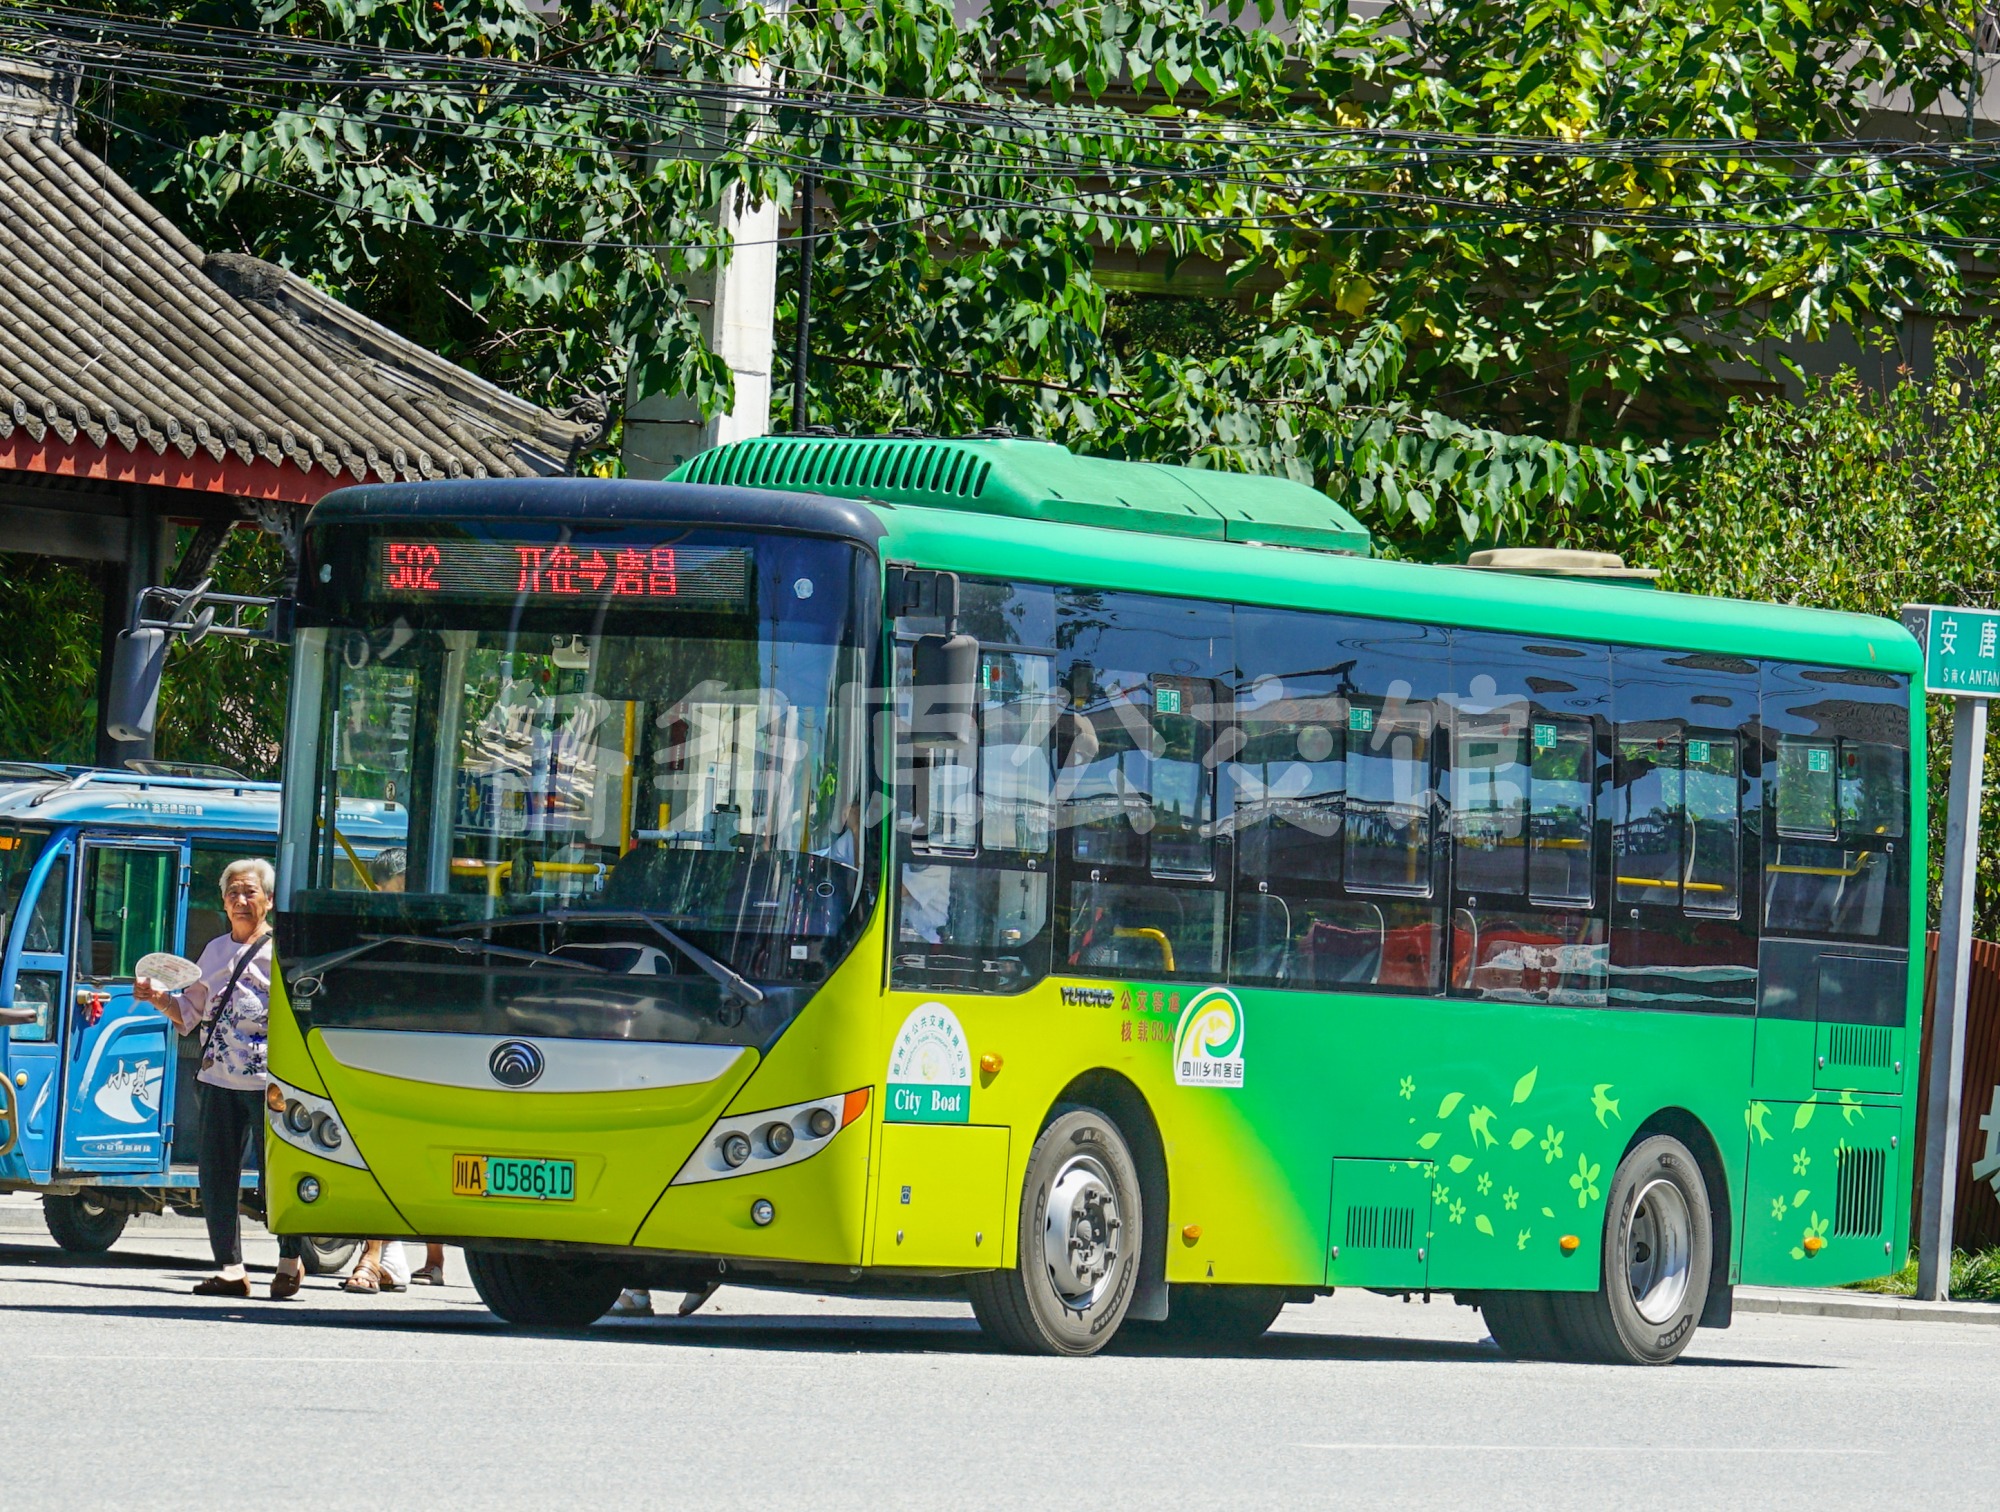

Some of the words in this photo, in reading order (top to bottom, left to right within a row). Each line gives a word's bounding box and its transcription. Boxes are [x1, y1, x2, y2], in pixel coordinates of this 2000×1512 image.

[389, 544, 440, 589] 502
[1940, 616, 1998, 659] 安唐
[1061, 986, 1115, 1006] YUTONG
[1182, 1061, 1242, 1078] 四川乡村客运
[894, 1089, 921, 1115] City
[931, 1090, 961, 1112] Boat
[1659, 1316, 1689, 1347] MA236
